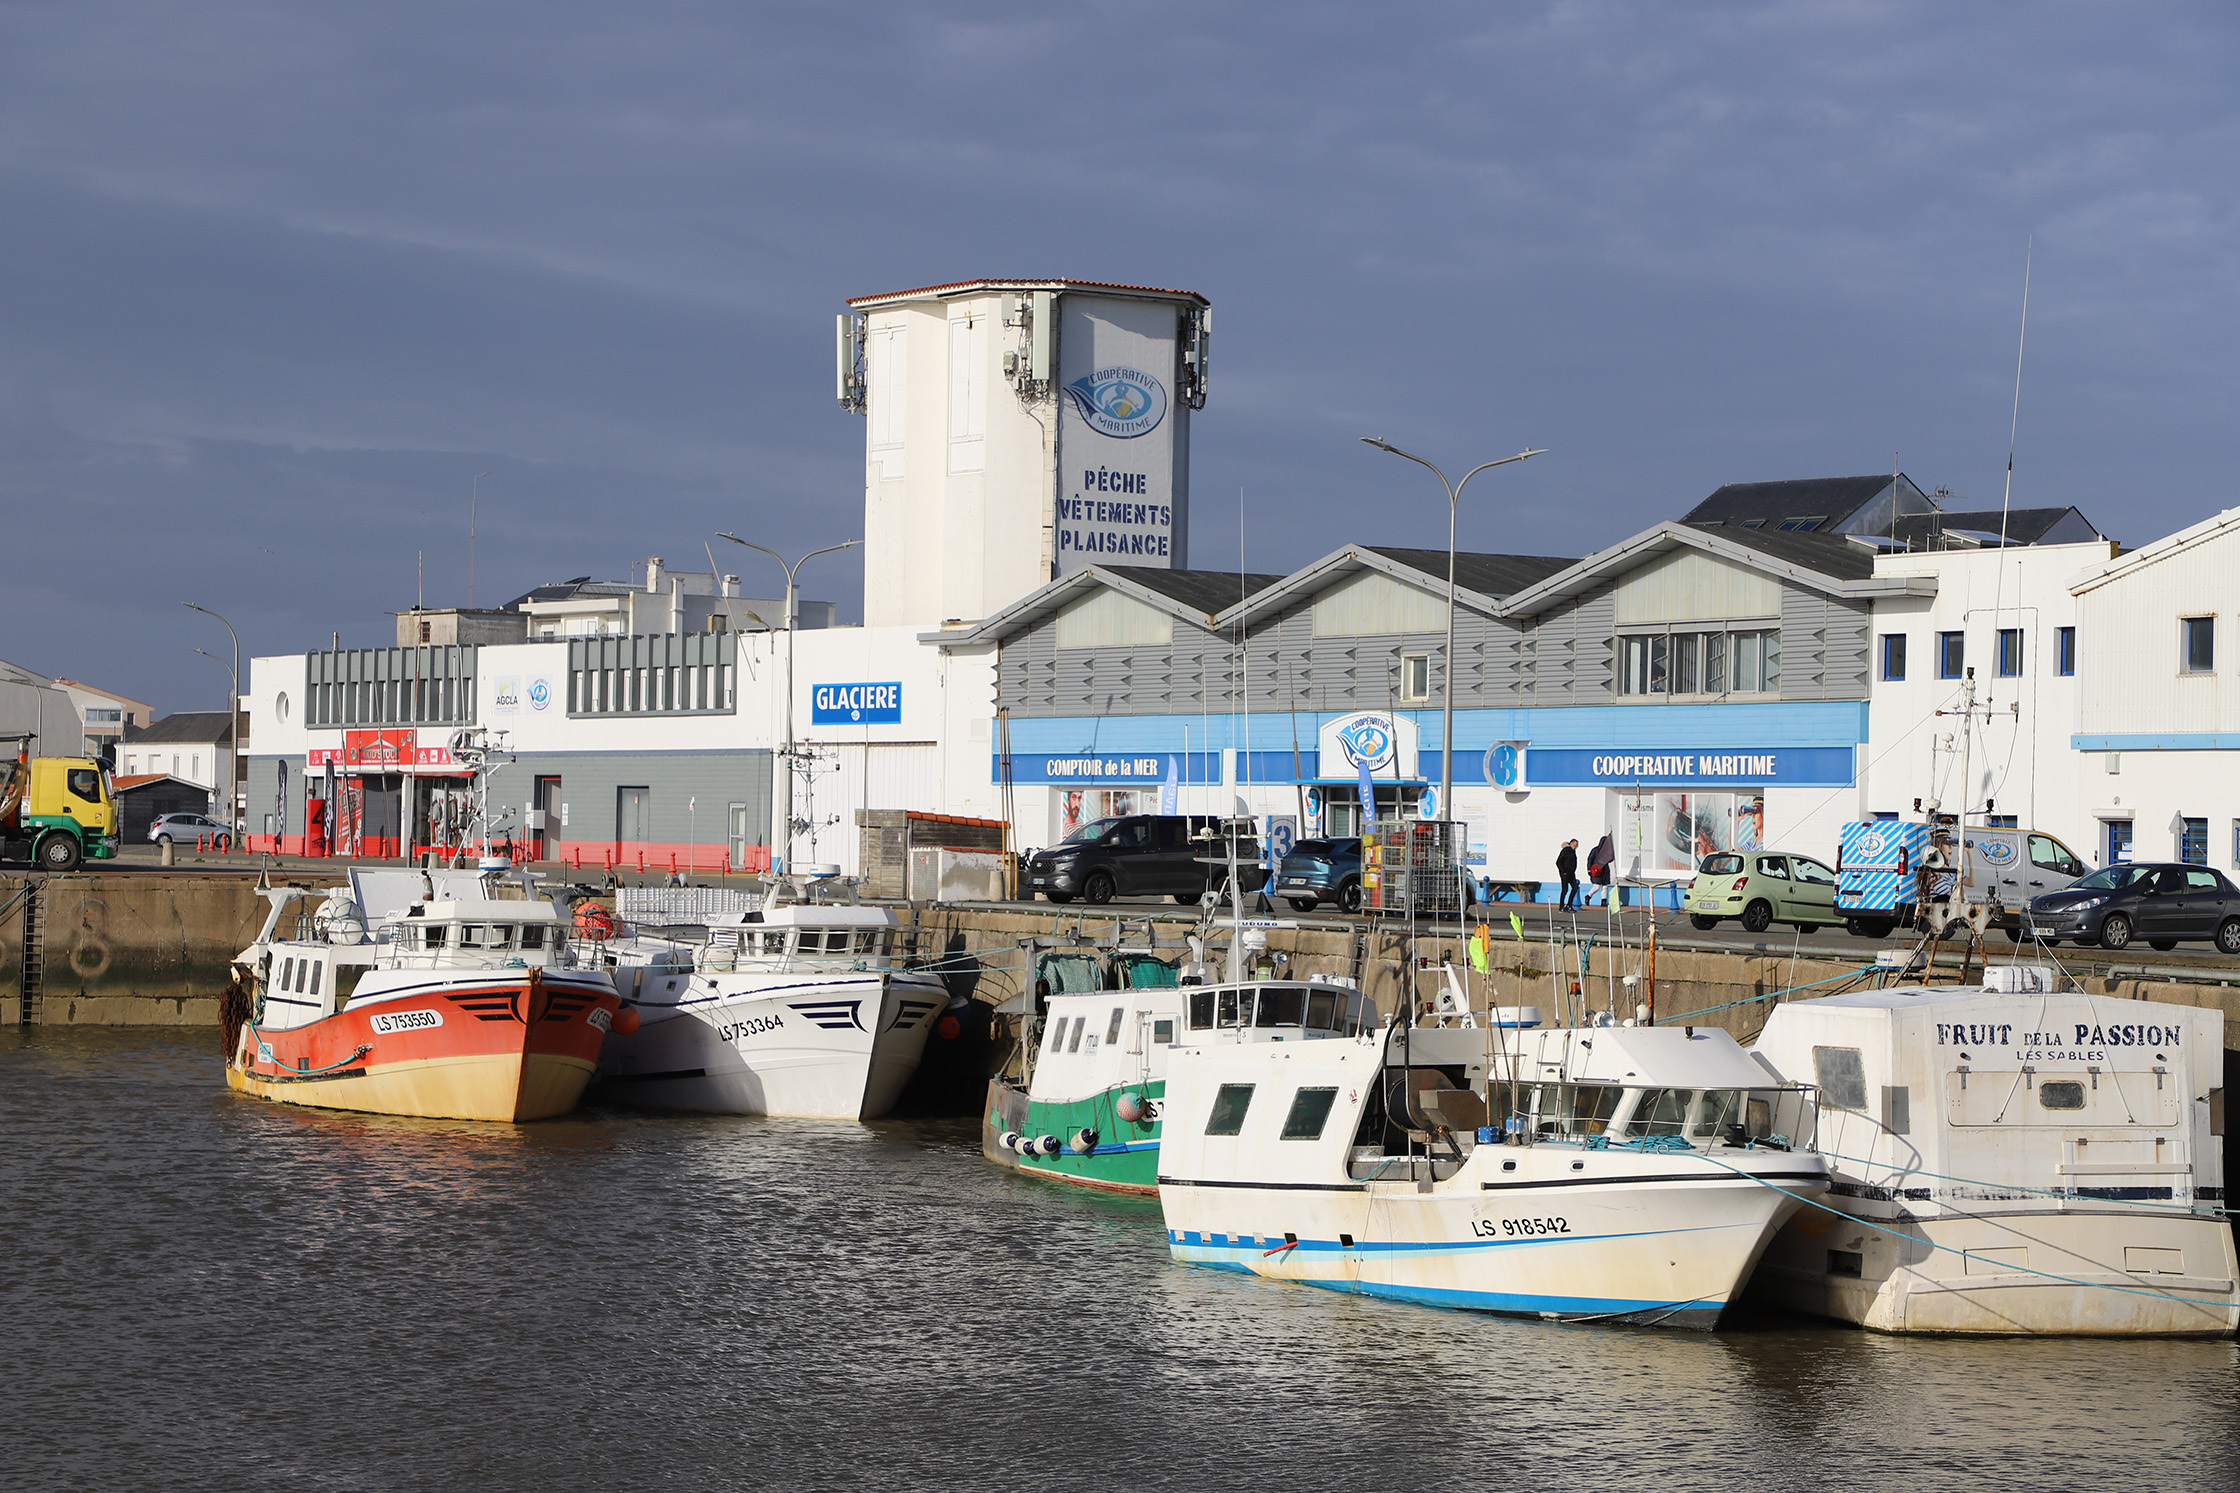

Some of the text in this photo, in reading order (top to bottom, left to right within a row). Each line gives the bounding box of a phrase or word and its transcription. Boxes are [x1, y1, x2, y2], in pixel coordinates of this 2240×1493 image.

[1089, 367, 1157, 392] COOPÉRATIVE
[1096, 415, 1152, 433] MARITIME
[1084, 465, 1146, 494] PÊCHE
[1059, 493, 1171, 527] VÊTEMENTS
[1060, 529, 1168, 556] PLAISANCE
[495, 695, 519, 705] AGCLA
[816, 685, 898, 710] GLACIERE
[1046, 758, 1158, 776] COMPTOIR de la MER
[1592, 754, 1777, 776] COOPERATIVE MARITIME
[1423, 789, 1434, 816] 3
[1273, 825, 1292, 858] 3
[375, 1011, 436, 1032] LS 753550
[717, 1014, 784, 1042] LS 753364
[1936, 1023, 2181, 1046] FRUIT DE LA PASSION
[2016, 1050, 2104, 1061] LES SABLES
[1471, 1216, 1571, 1238] LS 918542
